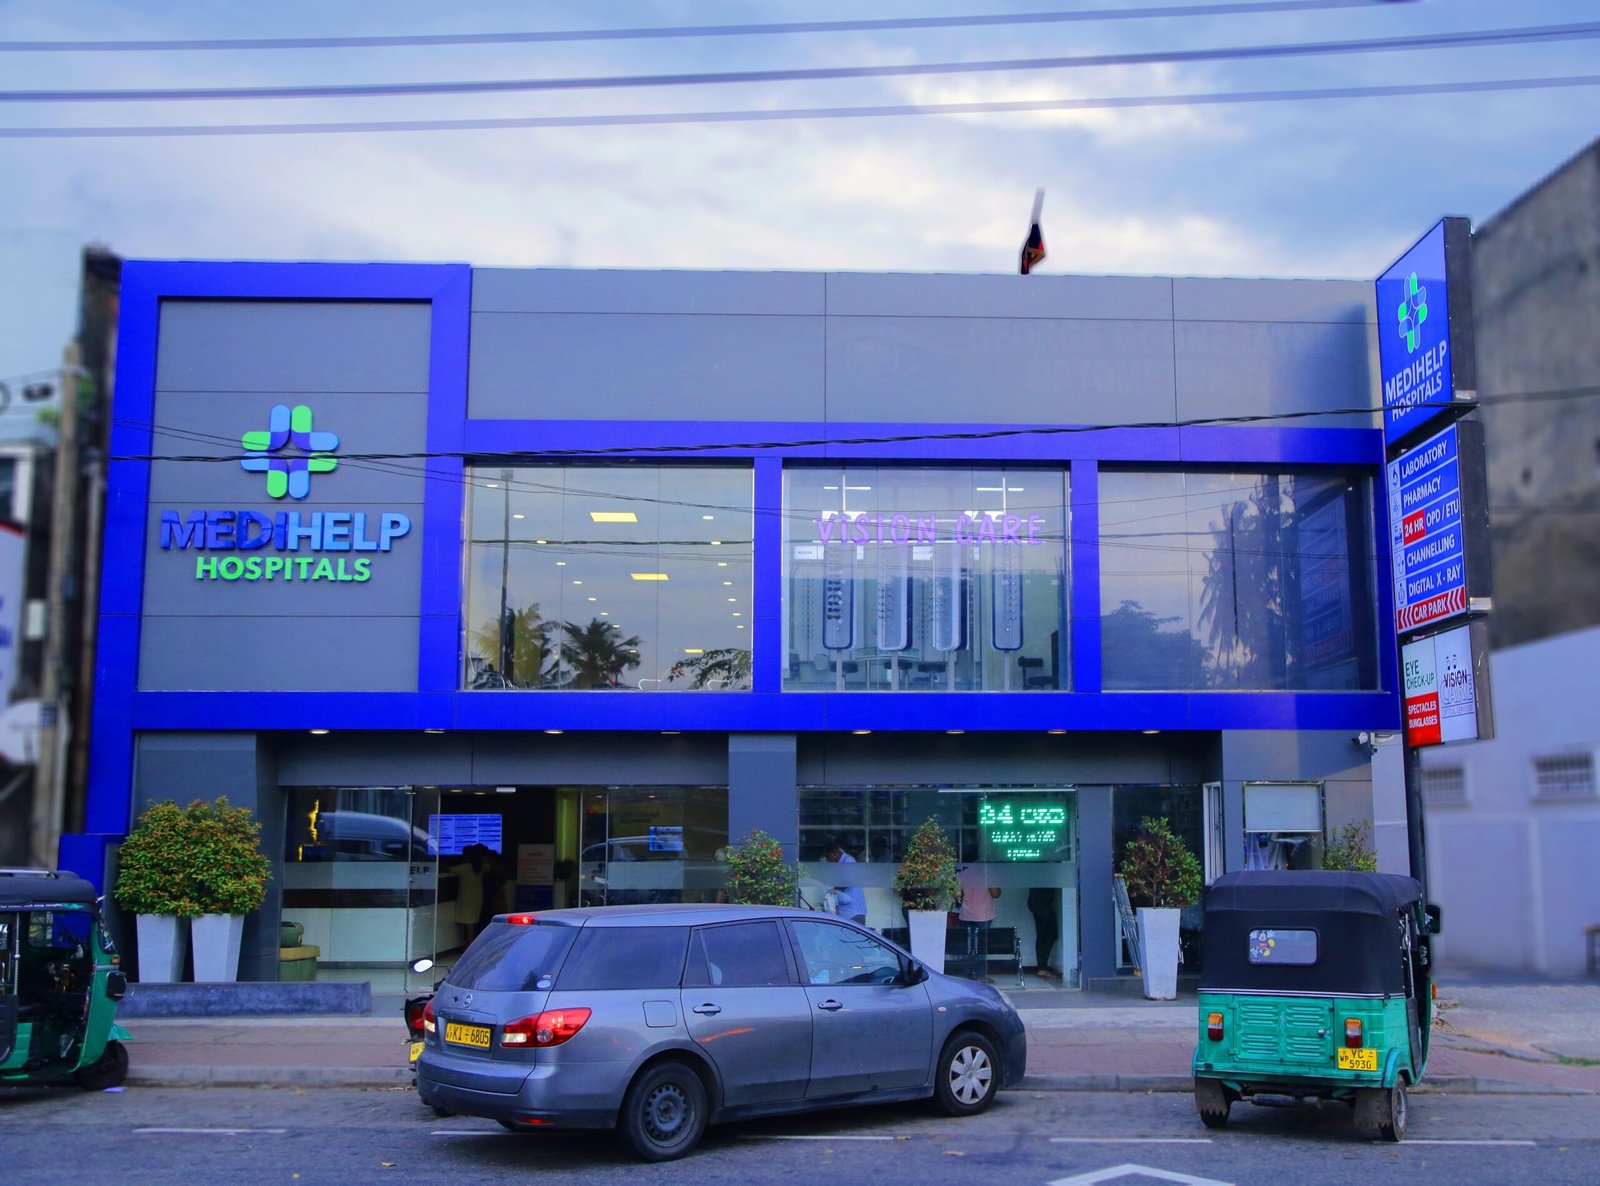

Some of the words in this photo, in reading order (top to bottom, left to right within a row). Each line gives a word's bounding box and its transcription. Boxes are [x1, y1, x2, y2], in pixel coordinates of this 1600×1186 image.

[1385, 340, 1447, 405] MEDIHELP
[1392, 372, 1442, 422] HOSPITALS
[1401, 439, 1447, 479] LABORATORY
[1403, 475, 1441, 508] PHARMACY
[160, 510, 411, 551] MEDIHELP
[815, 511, 937, 546] VISION
[954, 512, 1045, 546] CARE
[1404, 524, 1413, 538] 24
[1414, 518, 1424, 533] HR
[1426, 508, 1440, 527] OPD
[1445, 498, 1459, 518] ETU
[1406, 533, 1455, 567] CHANNELLING
[195, 556, 372, 582] HOSPITALS
[1408, 575, 1435, 597] DIGITAL
[1413, 605, 1427, 622] CAR
[1428, 597, 1447, 616] PARK
[1405, 659, 1420, 677] EYE
[1406, 672, 1435, 690] CHECK-UP
[1444, 668, 1468, 689] VISION
[1408, 700, 1437, 716] SPECTACLES
[1409, 714, 1438, 729] SUNGLASSES
